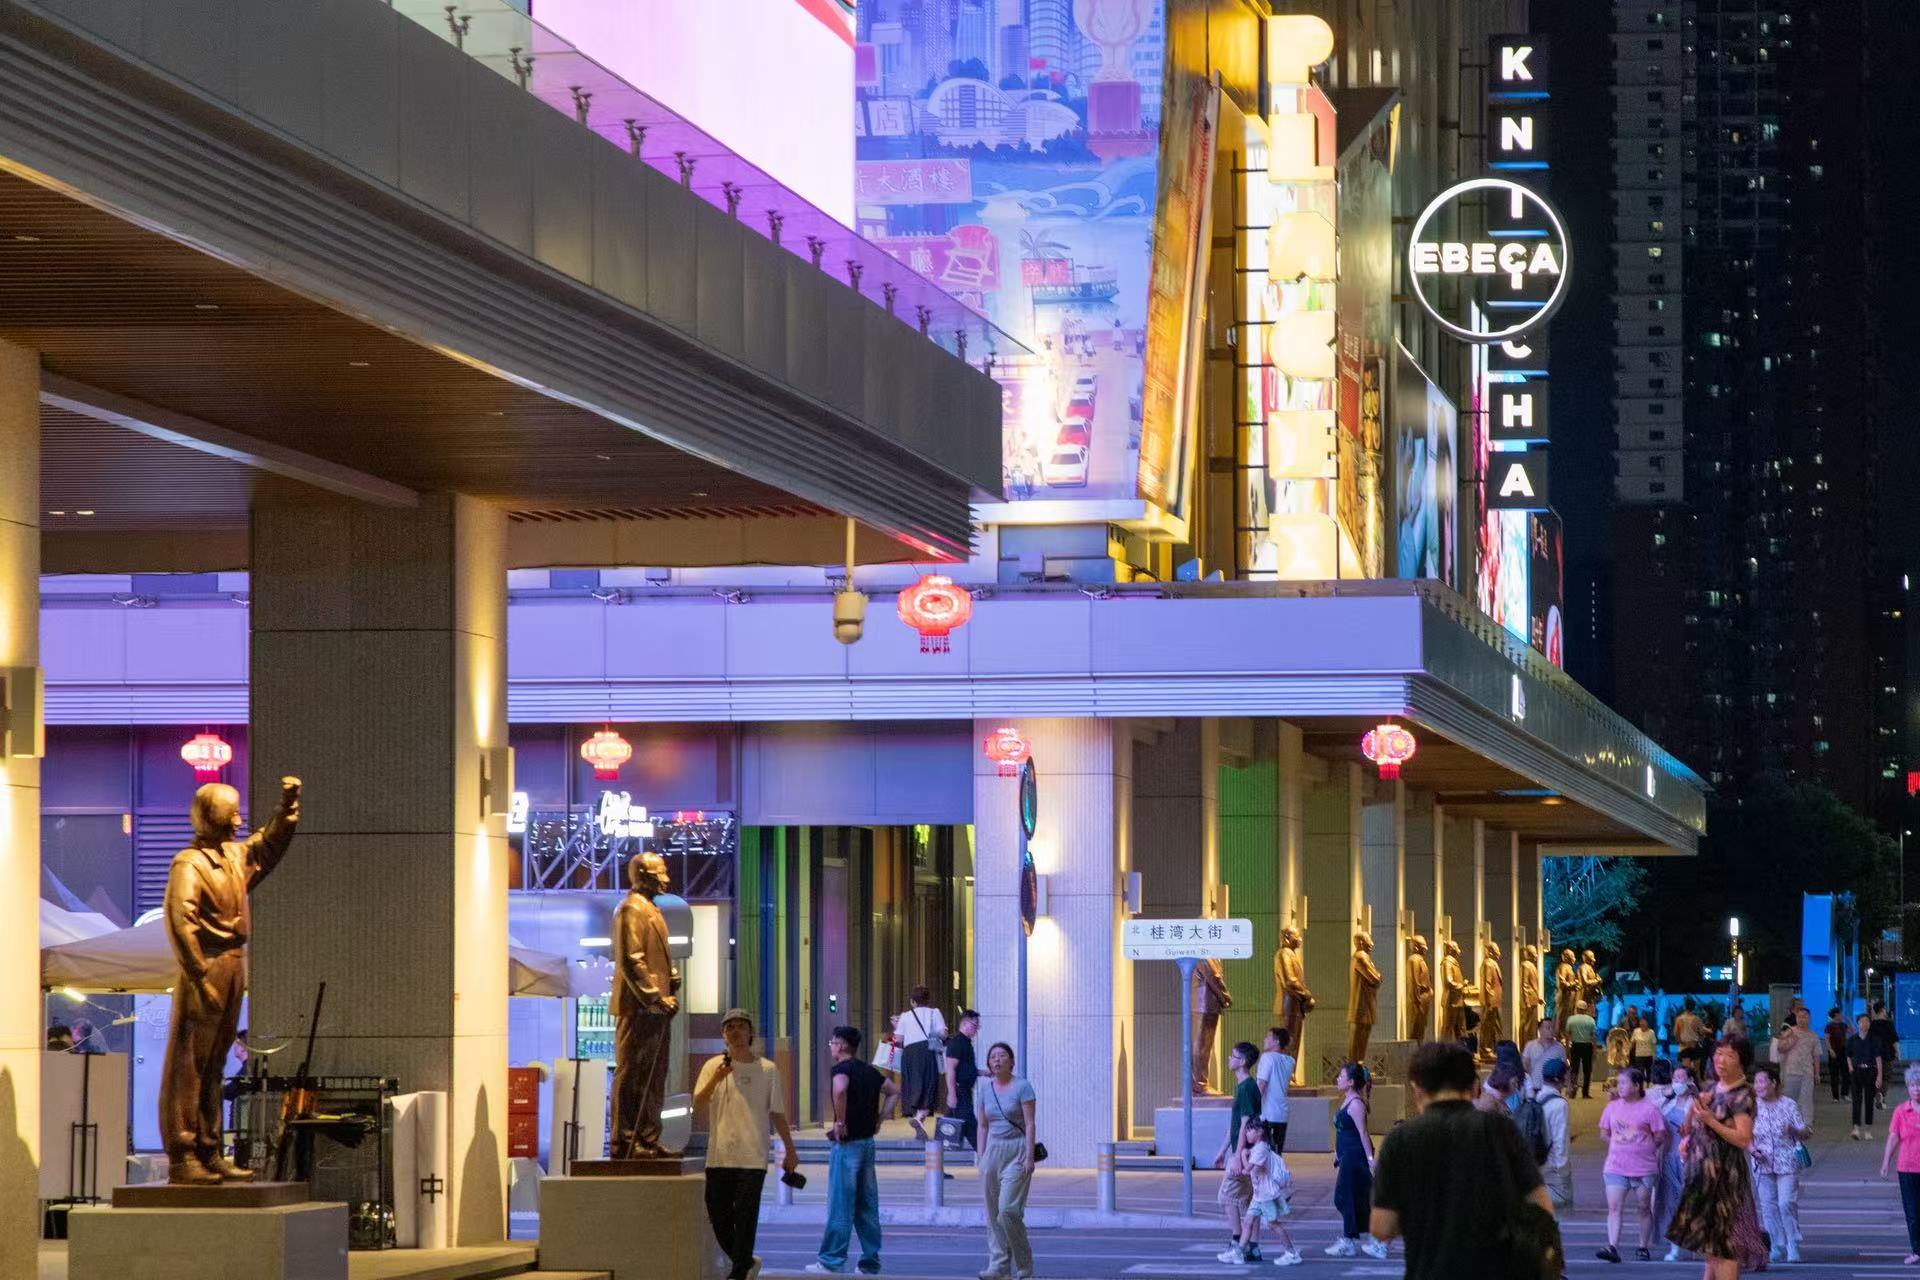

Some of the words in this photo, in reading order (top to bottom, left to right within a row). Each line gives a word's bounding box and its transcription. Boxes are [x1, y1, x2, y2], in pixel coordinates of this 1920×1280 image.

[1131, 924, 1140, 935] 北
[1150, 924, 1223, 940] 桂湾大街
[1132, 949, 1140, 957] N
[1233, 948, 1240, 956] S
